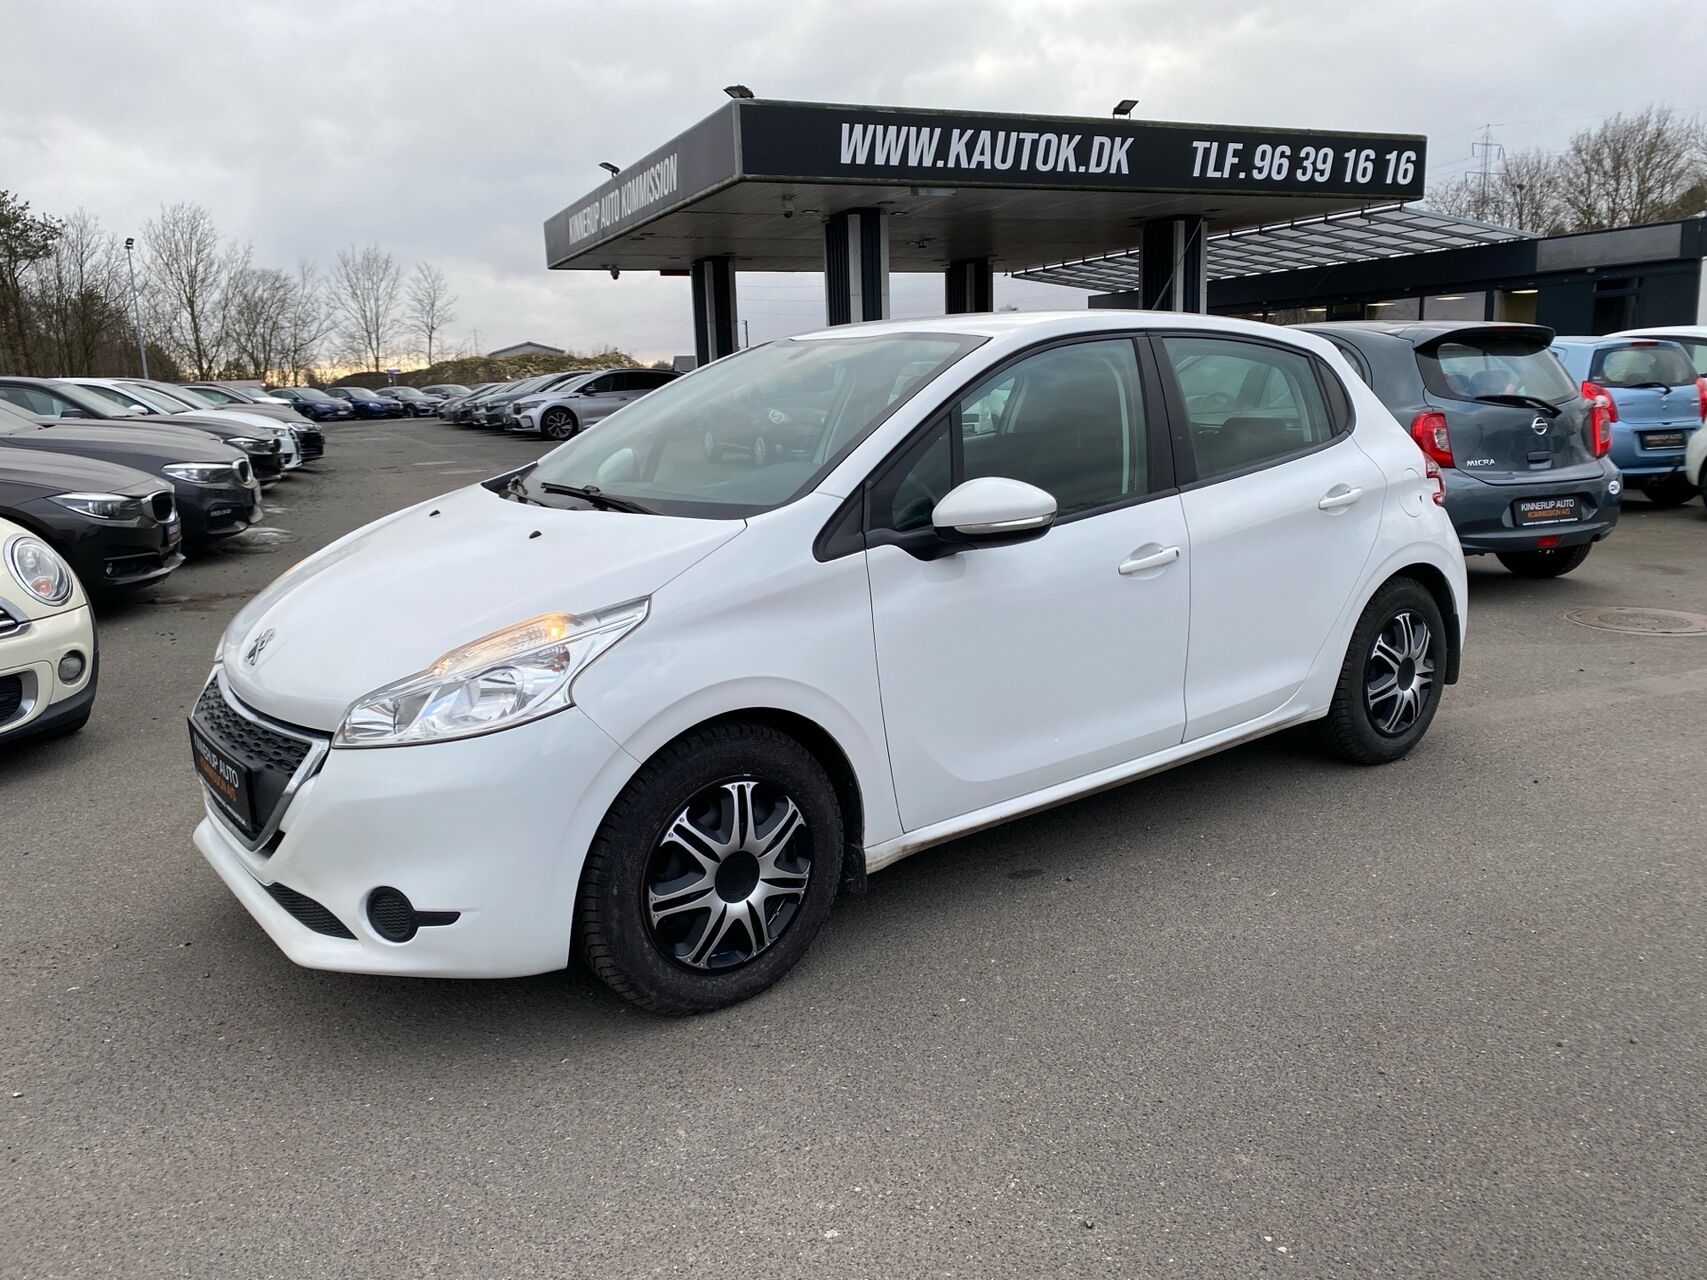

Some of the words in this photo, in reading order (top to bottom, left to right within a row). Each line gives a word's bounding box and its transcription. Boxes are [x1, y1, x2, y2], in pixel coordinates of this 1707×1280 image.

[840, 122, 1135, 175] WWW.KAUTOK.DK
[1192, 140, 1246, 179] TLF.
[1252, 143, 1291, 181] 96
[1296, 146, 1334, 183] 39
[1343, 148, 1376, 184] 16
[1385, 150, 1417, 185] 16
[600, 189, 620, 229] AUTO
[621, 153, 678, 218] KOMMISSION
[1466, 458, 1496, 467] MICRA
[1521, 502, 1556, 511] KINNERUP
[1556, 498, 1575, 508] AUTO
[219, 759, 239, 788] AUTO
